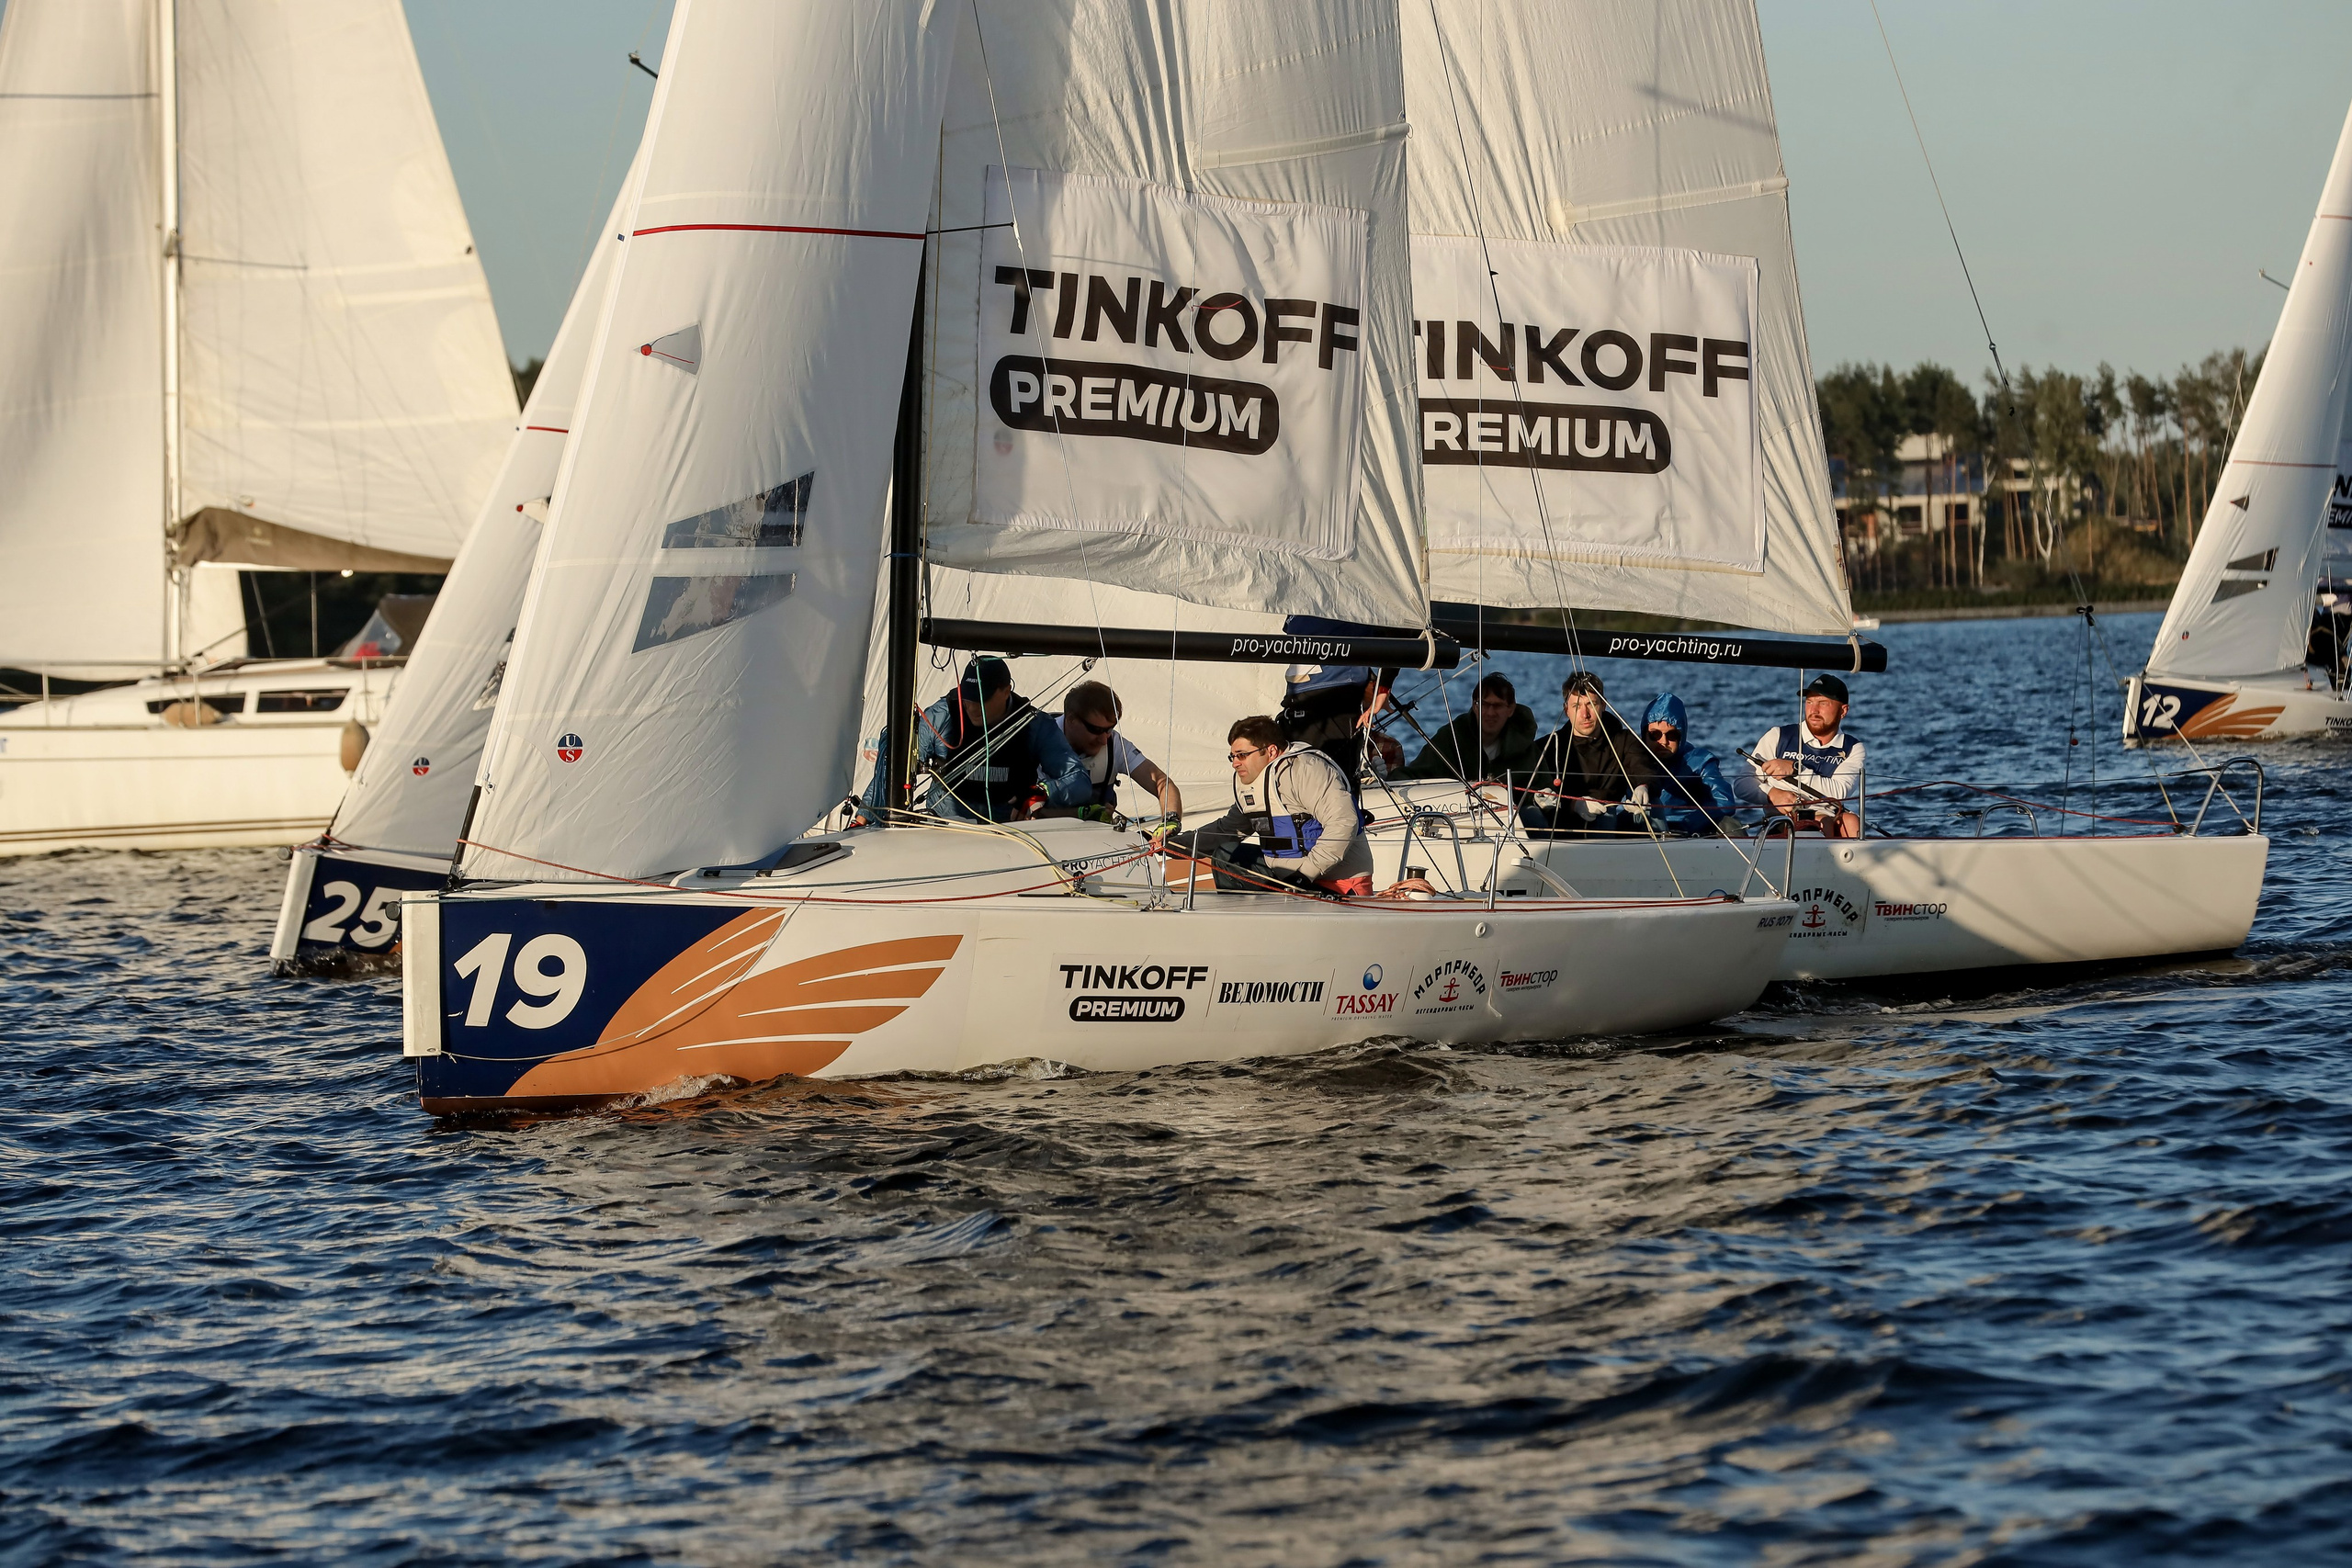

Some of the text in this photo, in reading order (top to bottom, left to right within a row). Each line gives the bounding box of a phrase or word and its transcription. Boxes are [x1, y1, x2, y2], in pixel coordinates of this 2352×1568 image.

[995, 265, 1359, 370] TINKOFF
[1414, 321, 1748, 397] INKOFF
[1009, 369, 1261, 440] PREMIUM
[1423, 412, 1657, 460] REMIUM
[1231, 637, 1351, 660] pro-yachting.ru
[1609, 637, 1742, 660] pro-yachting.ru
[2143, 694, 2181, 729] 12
[2325, 716, 2352, 727] TINKO
[301, 880, 401, 948] 25
[1791, 887, 1859, 922] РПРИБОР
[1757, 917, 1776, 928] RUS
[454, 933, 587, 1029] 19
[1059, 964, 1209, 990] TINKOFF
[1217, 981, 1326, 1006] ВЕДОМОСТИ
[1414, 959, 1487, 1000] МОРПРИБОР
[1076, 1000, 1178, 1017] PREMIUM
[1336, 993, 1399, 1014] TASSAY
